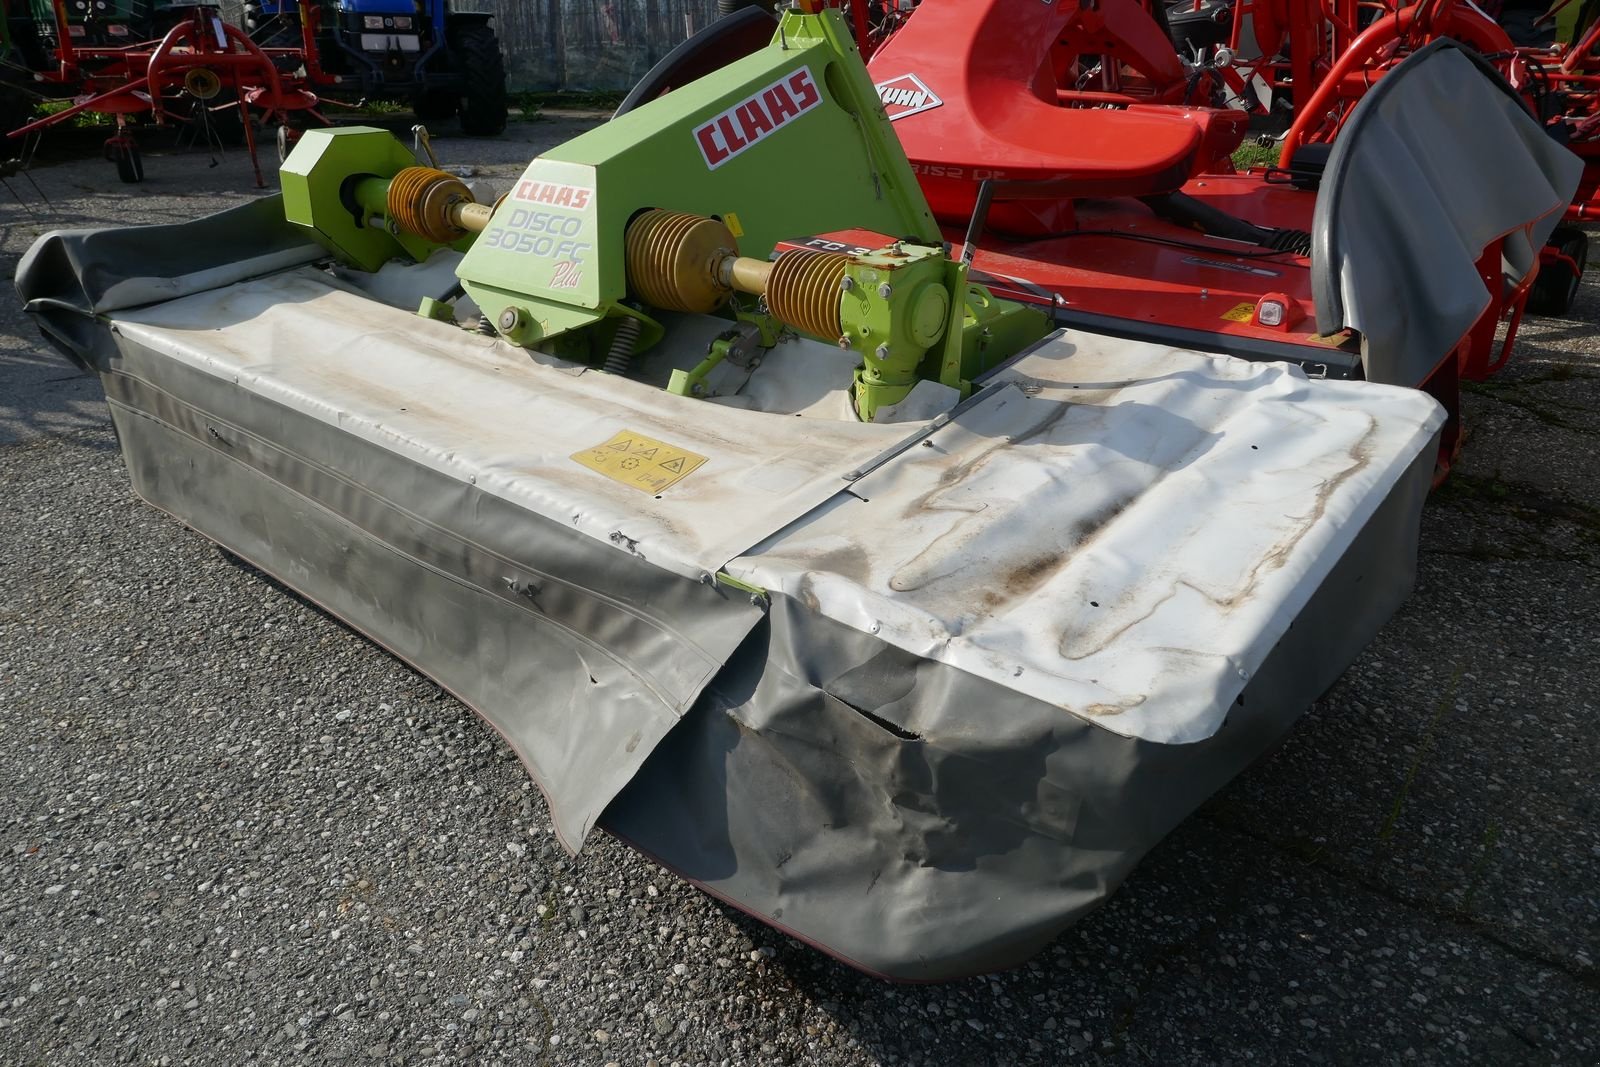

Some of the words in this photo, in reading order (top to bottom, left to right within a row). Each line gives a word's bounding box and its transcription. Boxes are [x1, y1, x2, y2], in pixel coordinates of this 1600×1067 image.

[696, 70, 819, 165] CLAAS
[515, 180, 590, 209] CLAAS
[508, 208, 583, 238] DISCO
[484, 227, 554, 256] 3050
[552, 240, 592, 265] FC
[805, 239, 846, 251] FC
[549, 260, 582, 289] Plus
